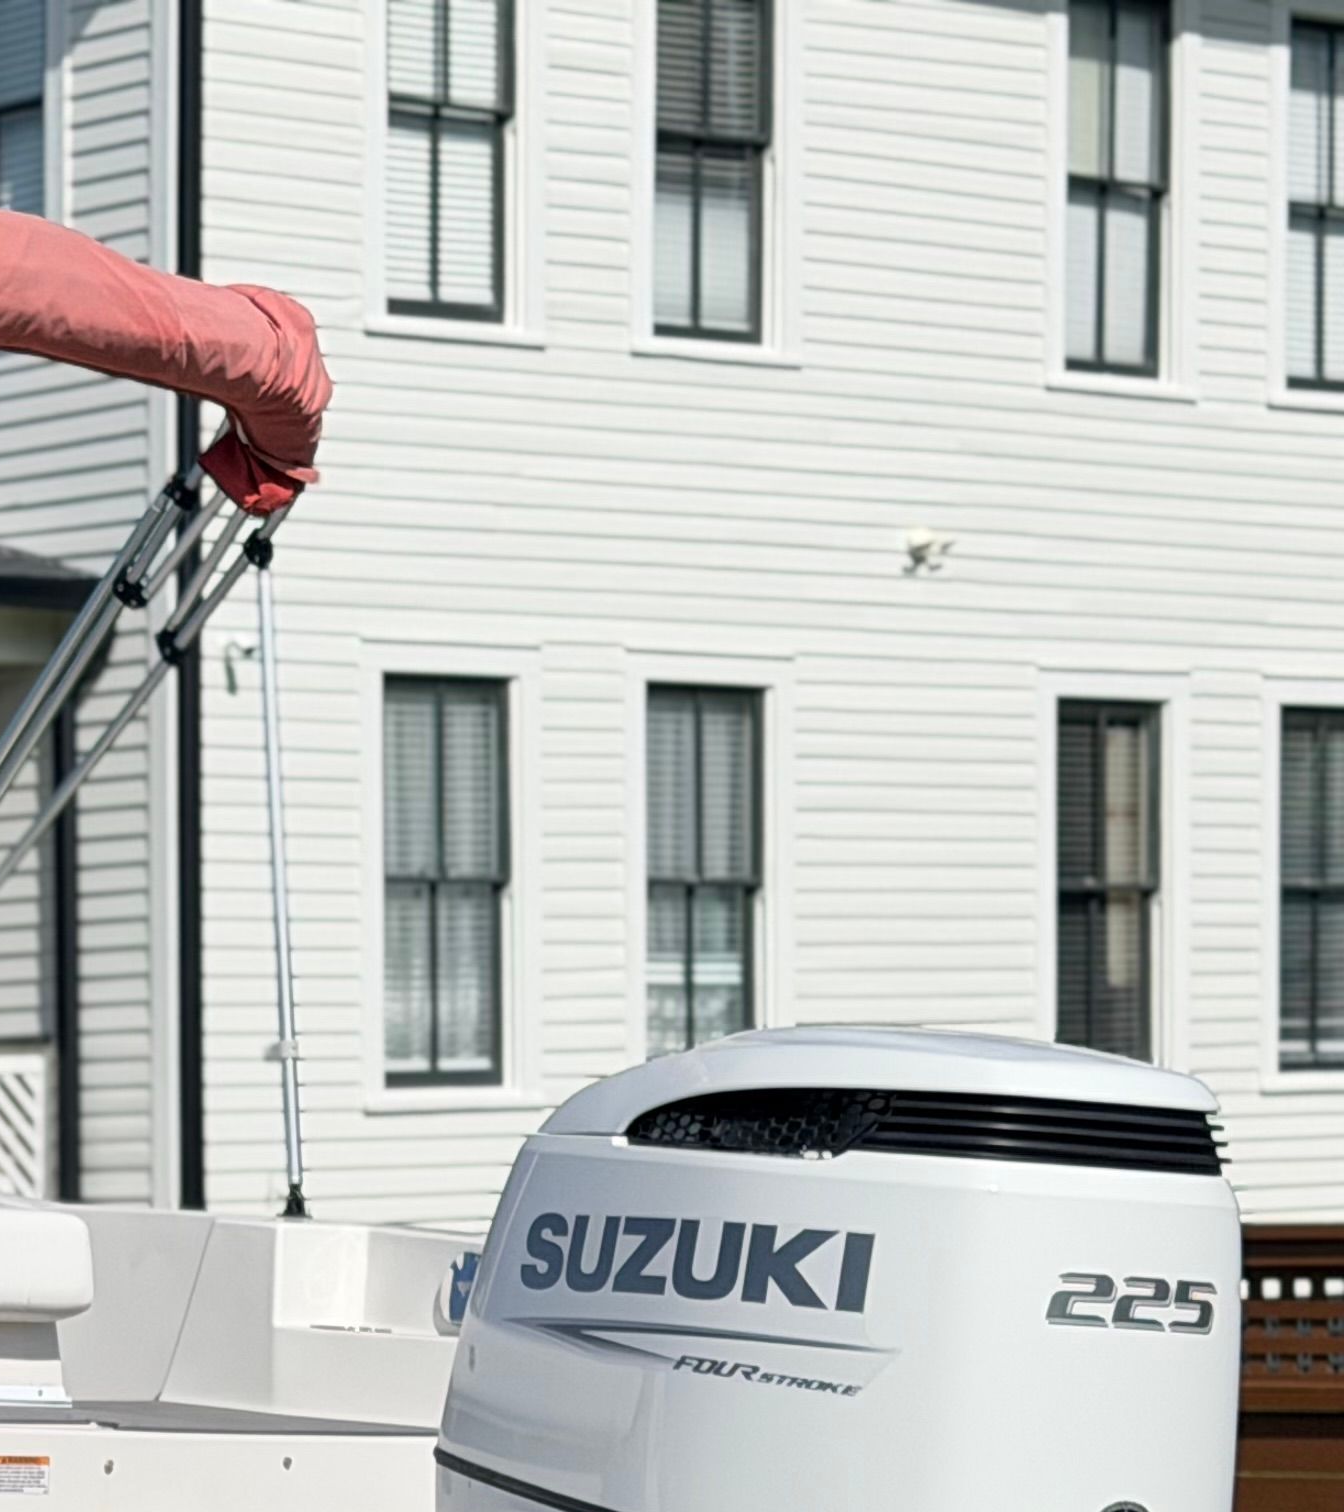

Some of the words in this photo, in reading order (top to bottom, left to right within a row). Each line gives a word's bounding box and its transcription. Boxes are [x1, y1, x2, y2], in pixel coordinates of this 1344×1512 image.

[520, 1212, 876, 1314] SUZUKI
[1046, 1272, 1218, 1335] 225
[673, 1355, 760, 1381] FOUR
[758, 1372, 863, 1397] STROKE
